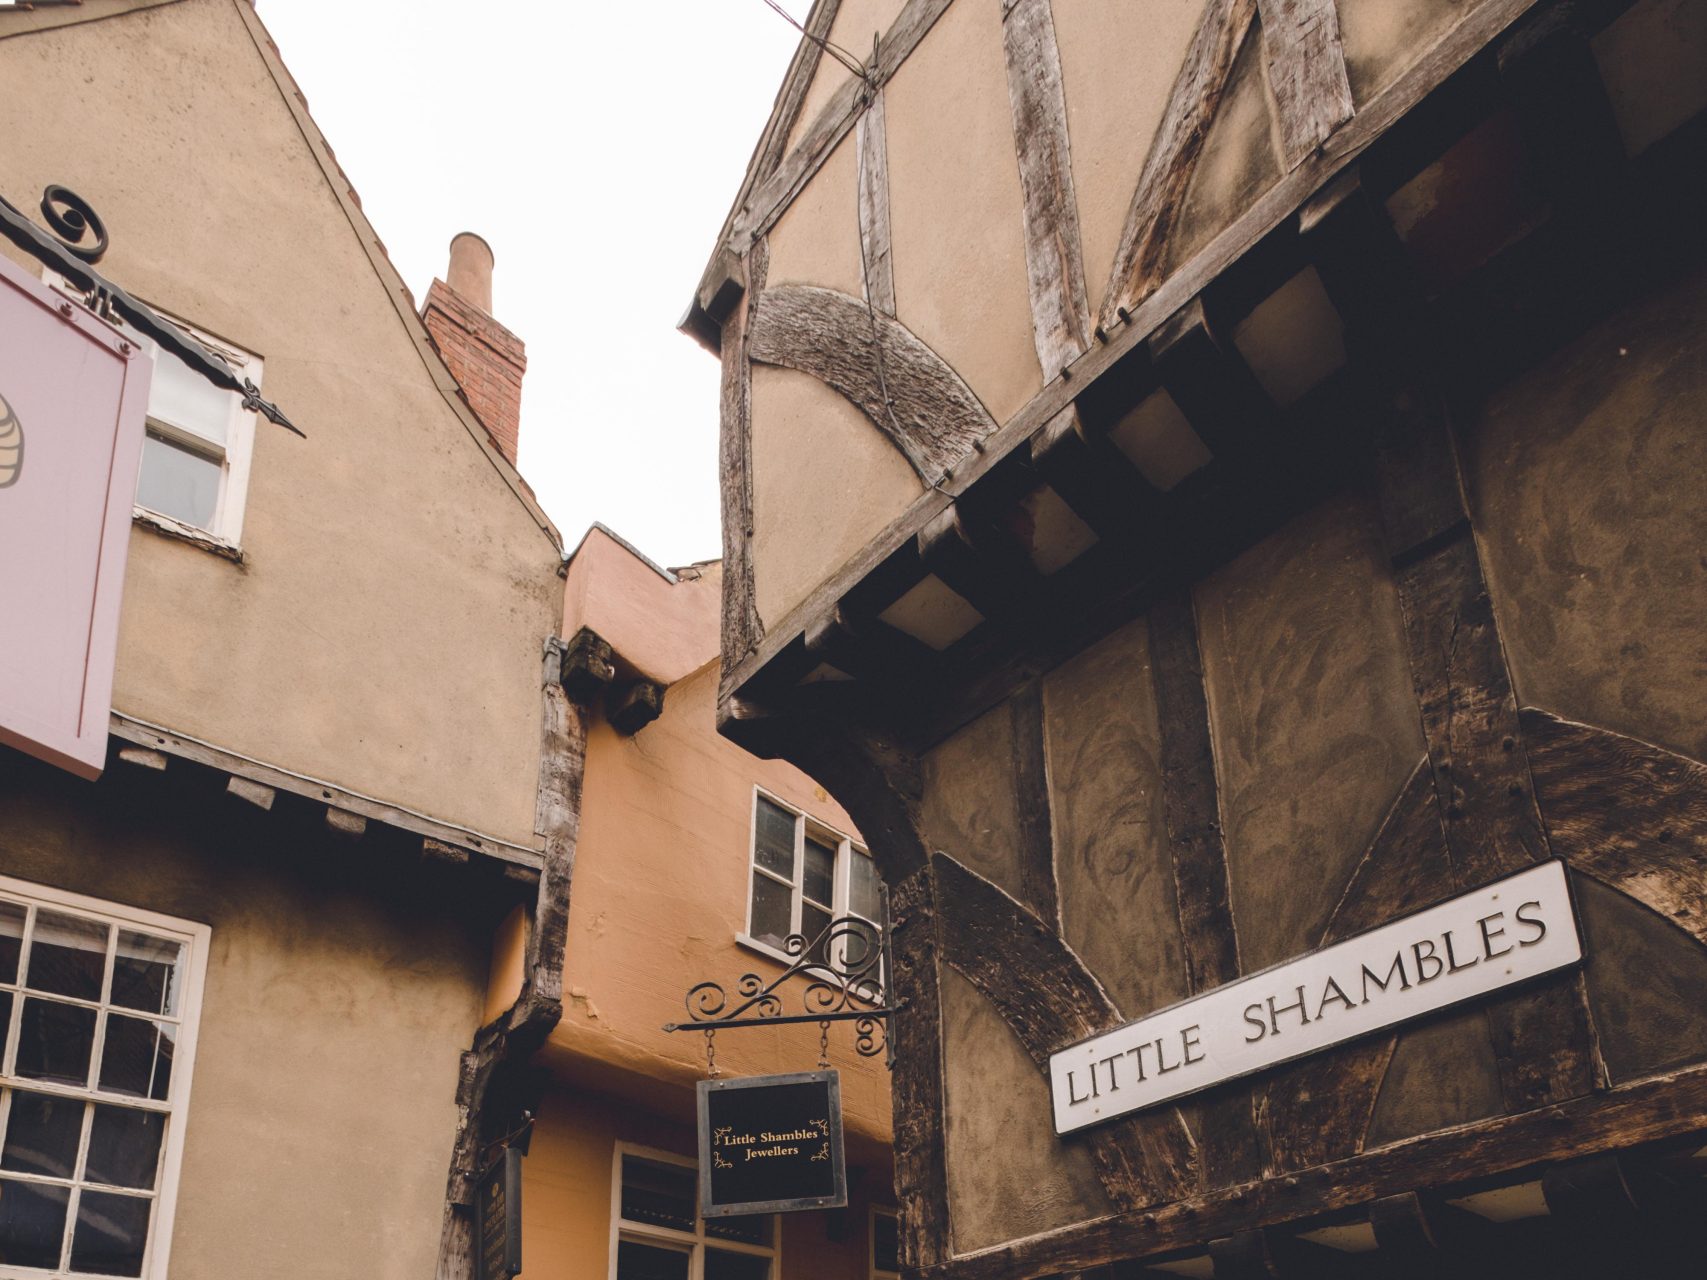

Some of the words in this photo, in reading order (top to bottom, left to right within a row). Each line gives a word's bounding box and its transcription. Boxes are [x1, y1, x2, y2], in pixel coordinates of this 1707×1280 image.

[1066, 1024, 1207, 1107] LITTLE
[1243, 900, 1549, 1045] SHAMBLES
[724, 1133, 756, 1146] Little
[760, 1129, 818, 1143] Shambles
[744, 1145, 799, 1161] Jewellers
